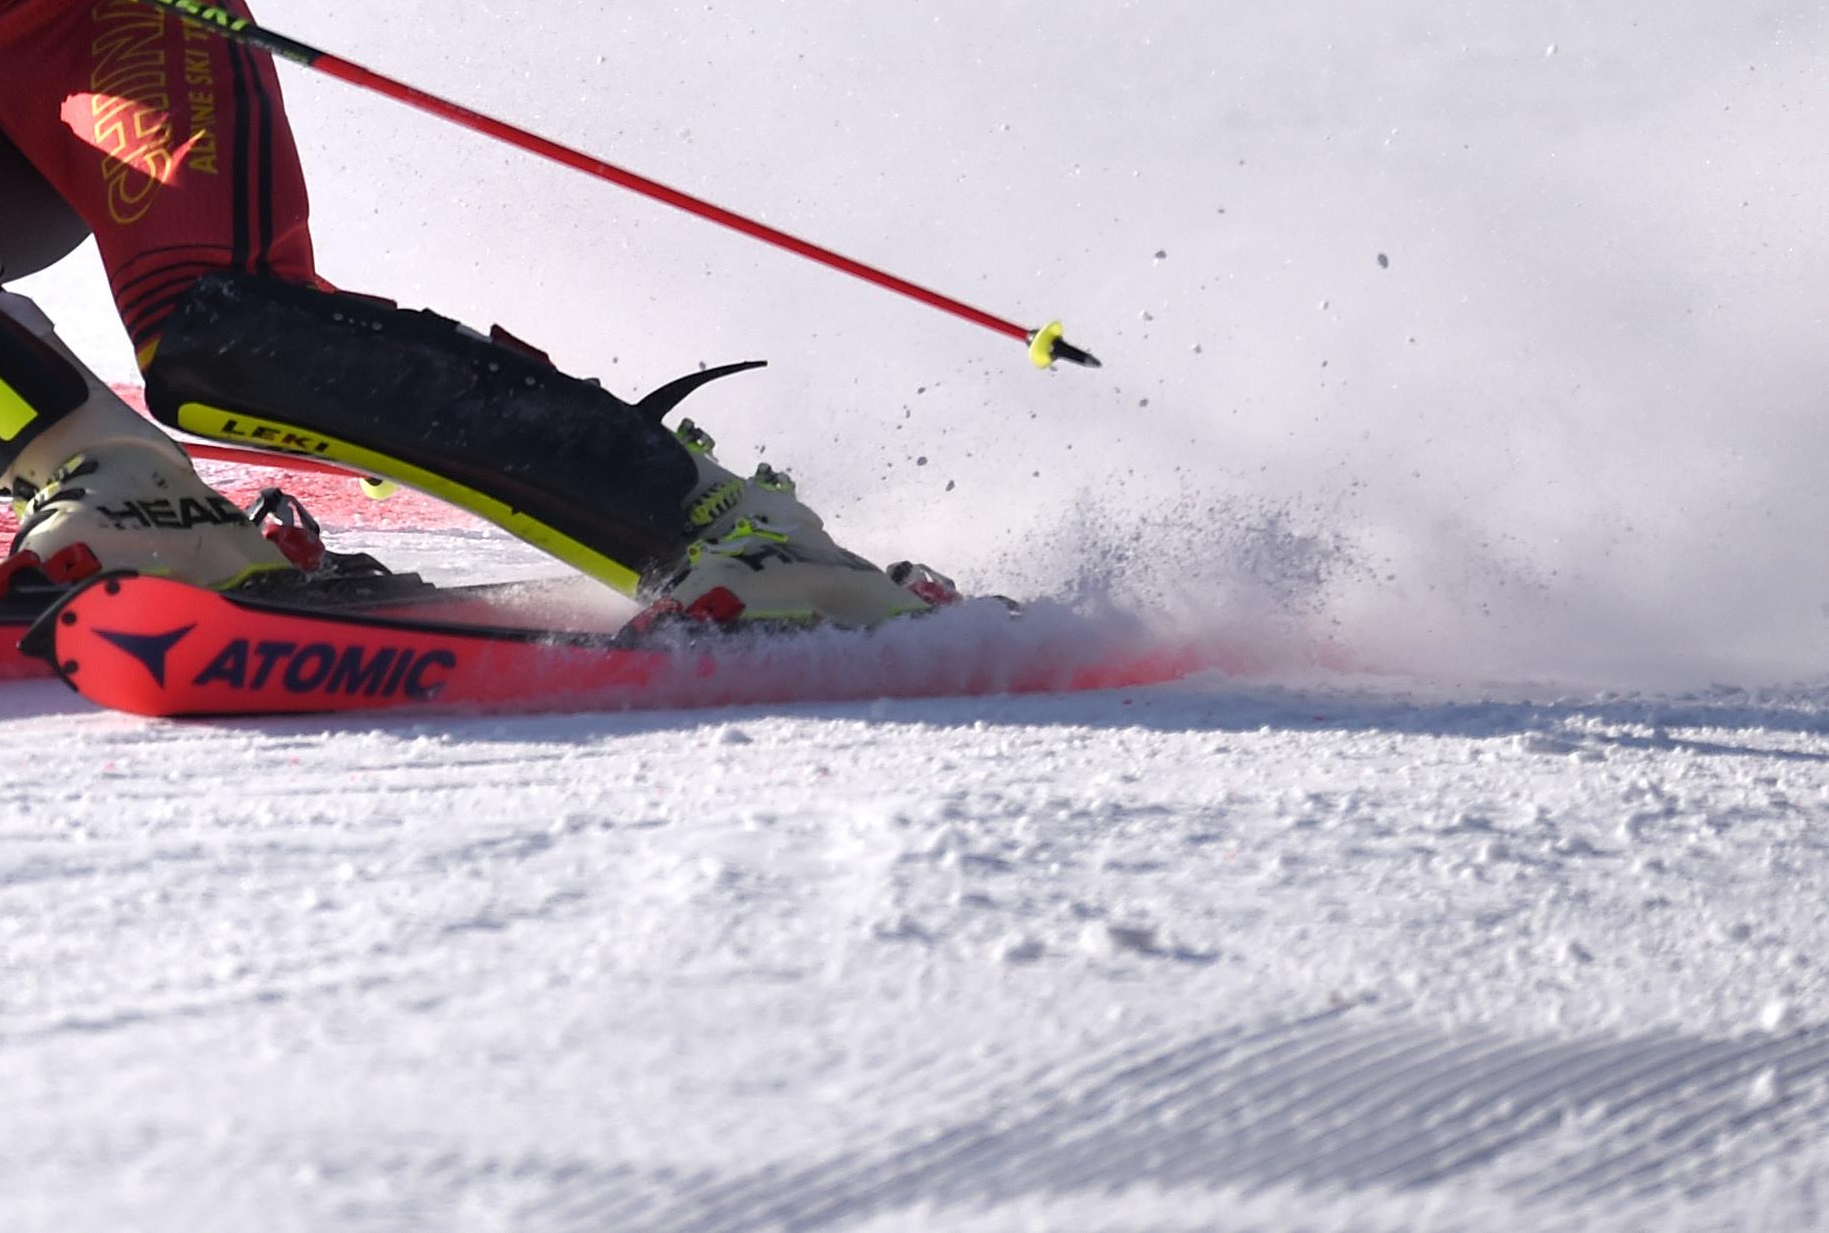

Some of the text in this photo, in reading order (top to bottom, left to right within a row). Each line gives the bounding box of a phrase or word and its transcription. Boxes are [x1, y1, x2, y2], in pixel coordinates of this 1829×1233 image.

[182, 48, 213, 84] SKI
[188, 92, 219, 174] ALPINE
[192, 638, 457, 700] ATOMIC
